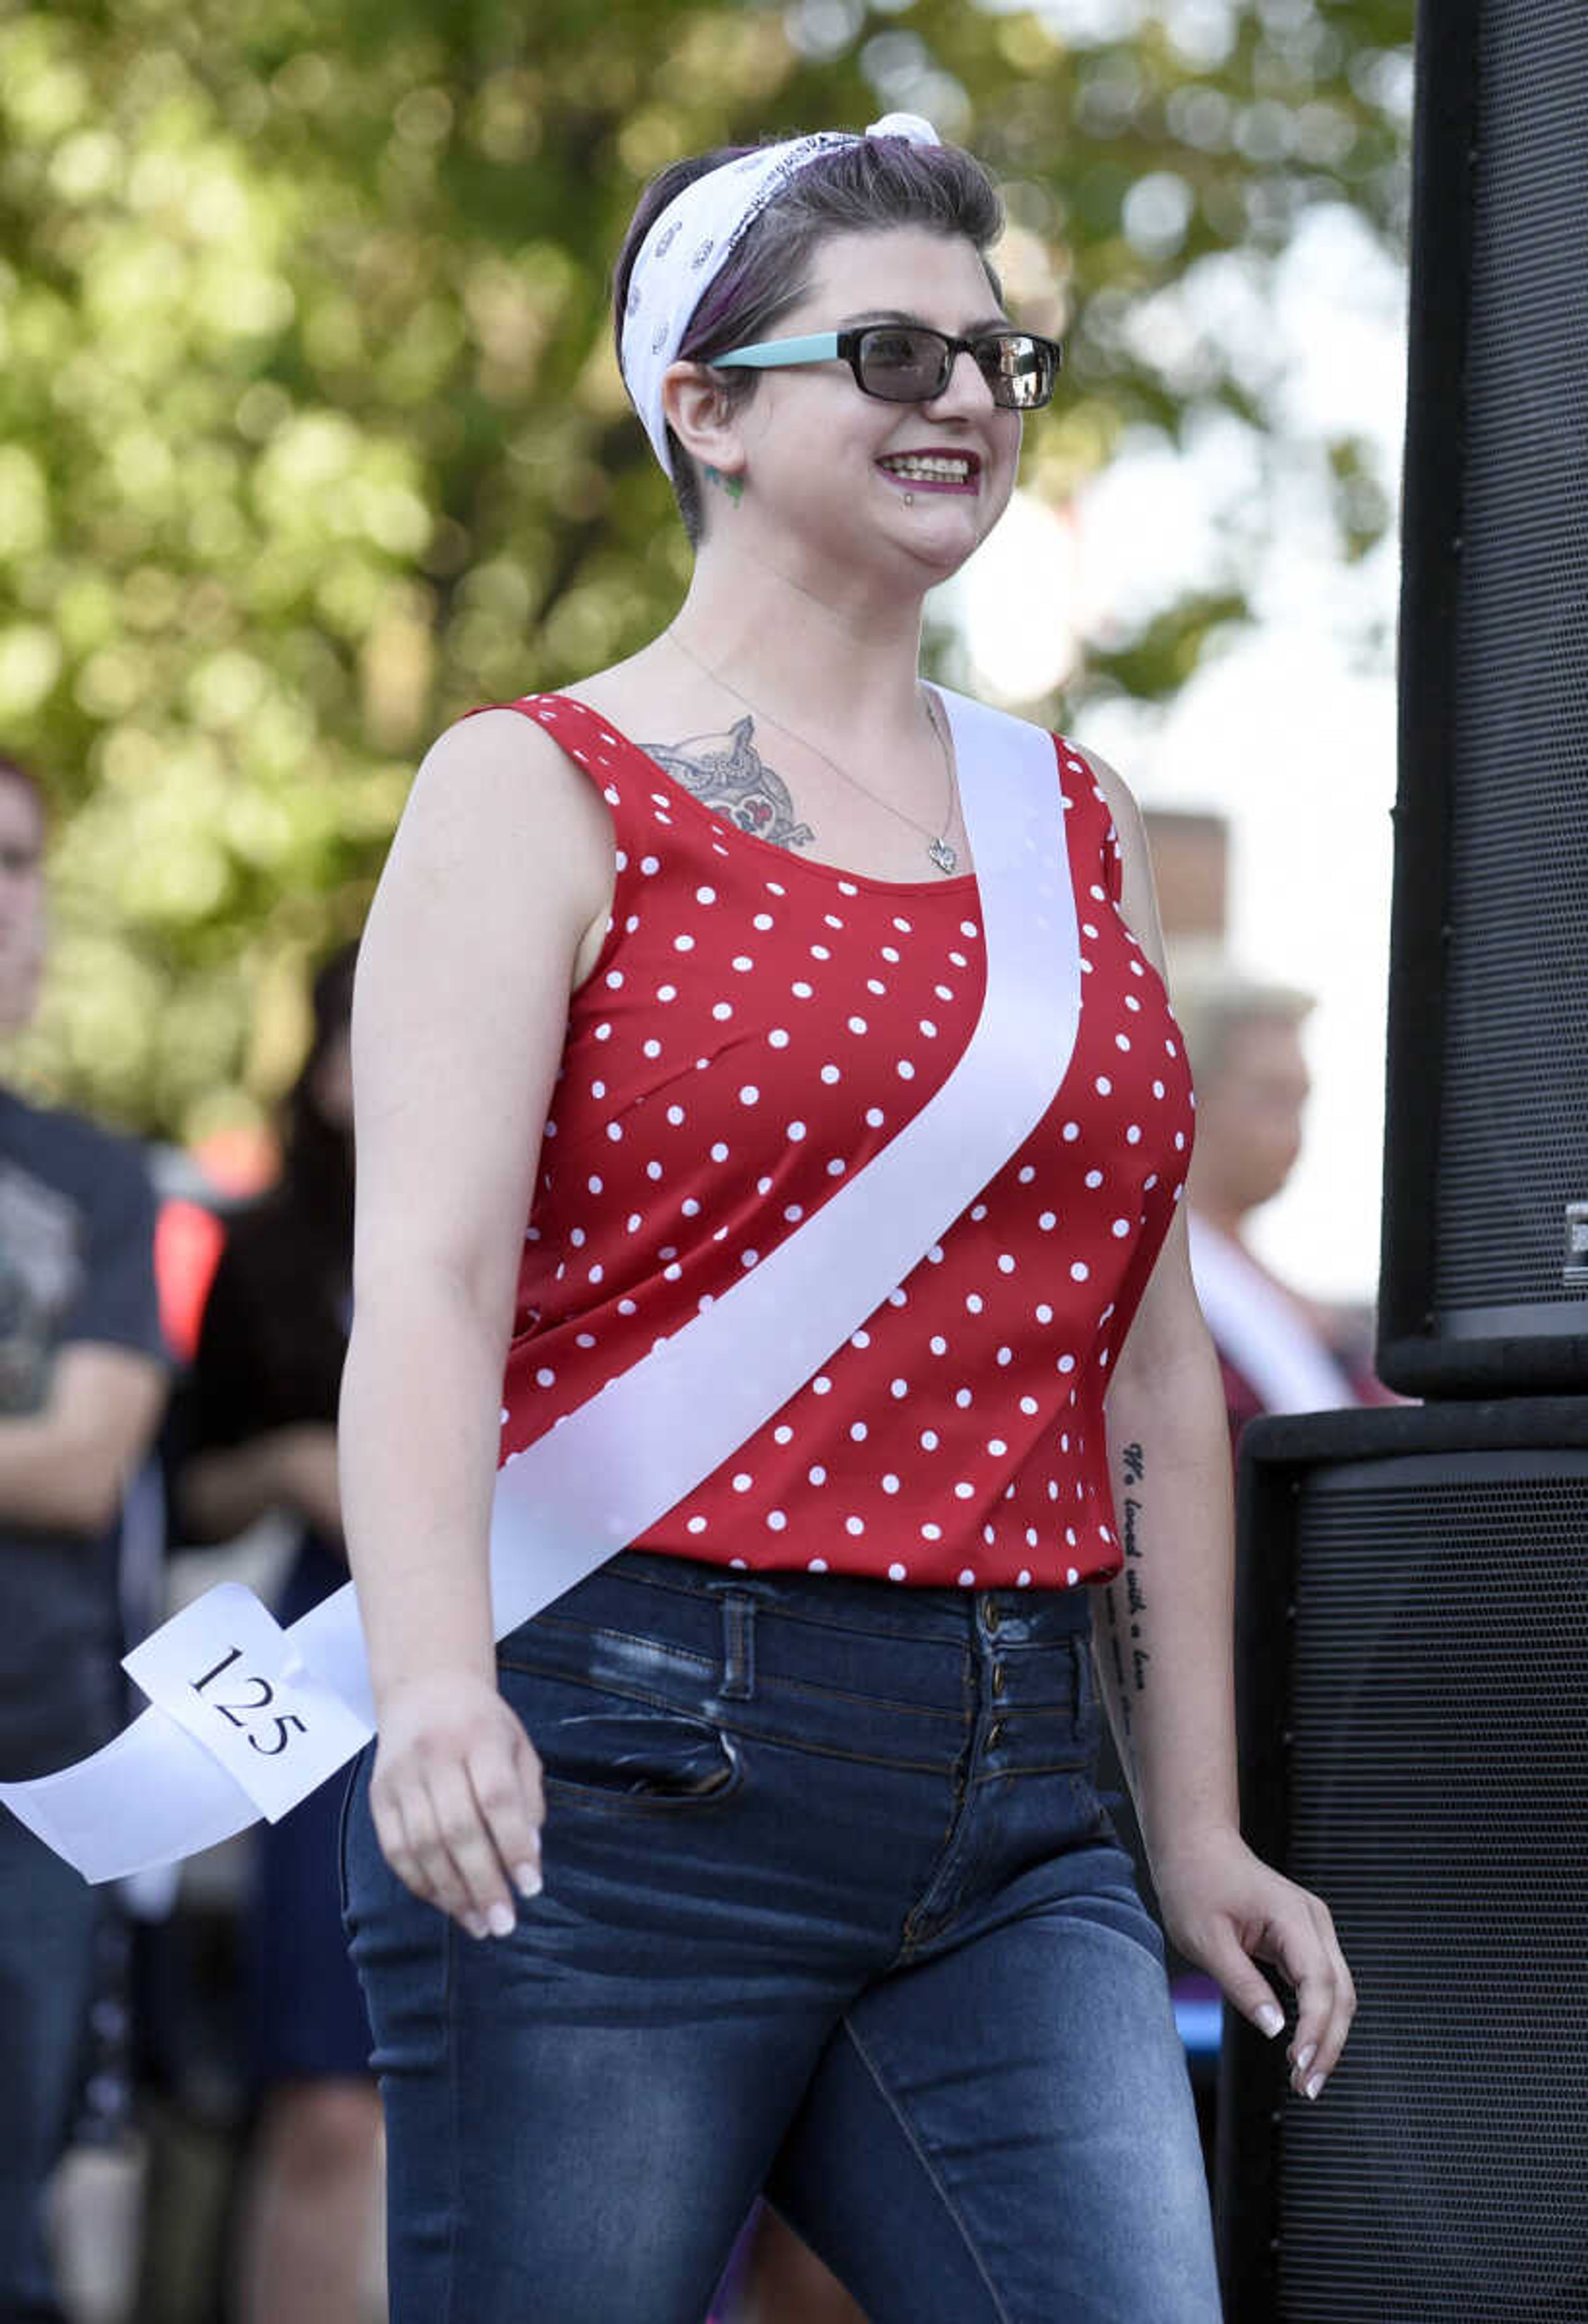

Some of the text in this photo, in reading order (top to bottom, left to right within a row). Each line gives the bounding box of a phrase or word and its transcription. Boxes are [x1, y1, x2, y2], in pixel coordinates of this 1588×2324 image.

[1123, 1443, 1143, 1485] We
[1125, 1499, 1142, 1557] loved
[189, 1646, 307, 1755] 125
